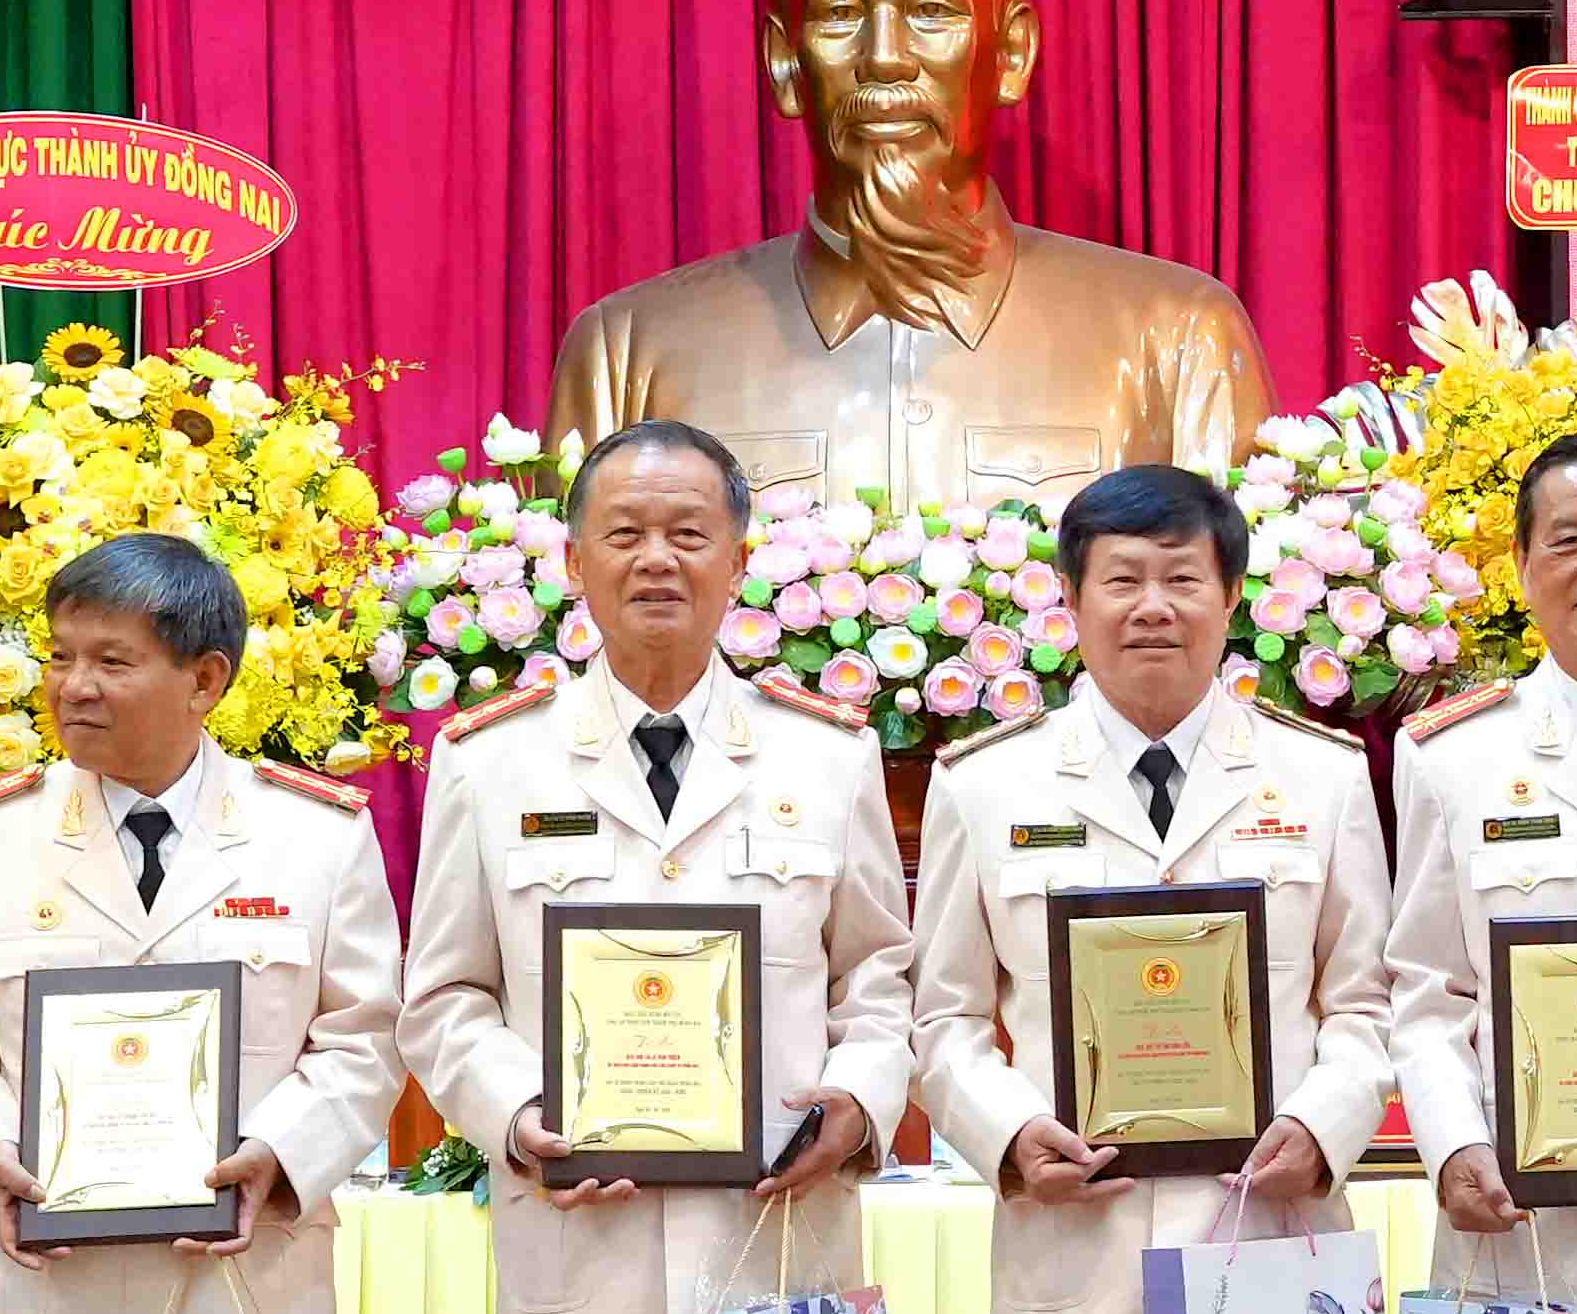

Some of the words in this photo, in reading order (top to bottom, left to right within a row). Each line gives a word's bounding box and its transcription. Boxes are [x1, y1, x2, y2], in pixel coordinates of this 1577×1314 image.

[33, 126, 117, 180] THÀNH
[126, 130, 157, 187] ỦY
[164, 141, 231, 211] ĐỒNG
[239, 178, 281, 235] NAI
[57, 205, 214, 265] Mừng
